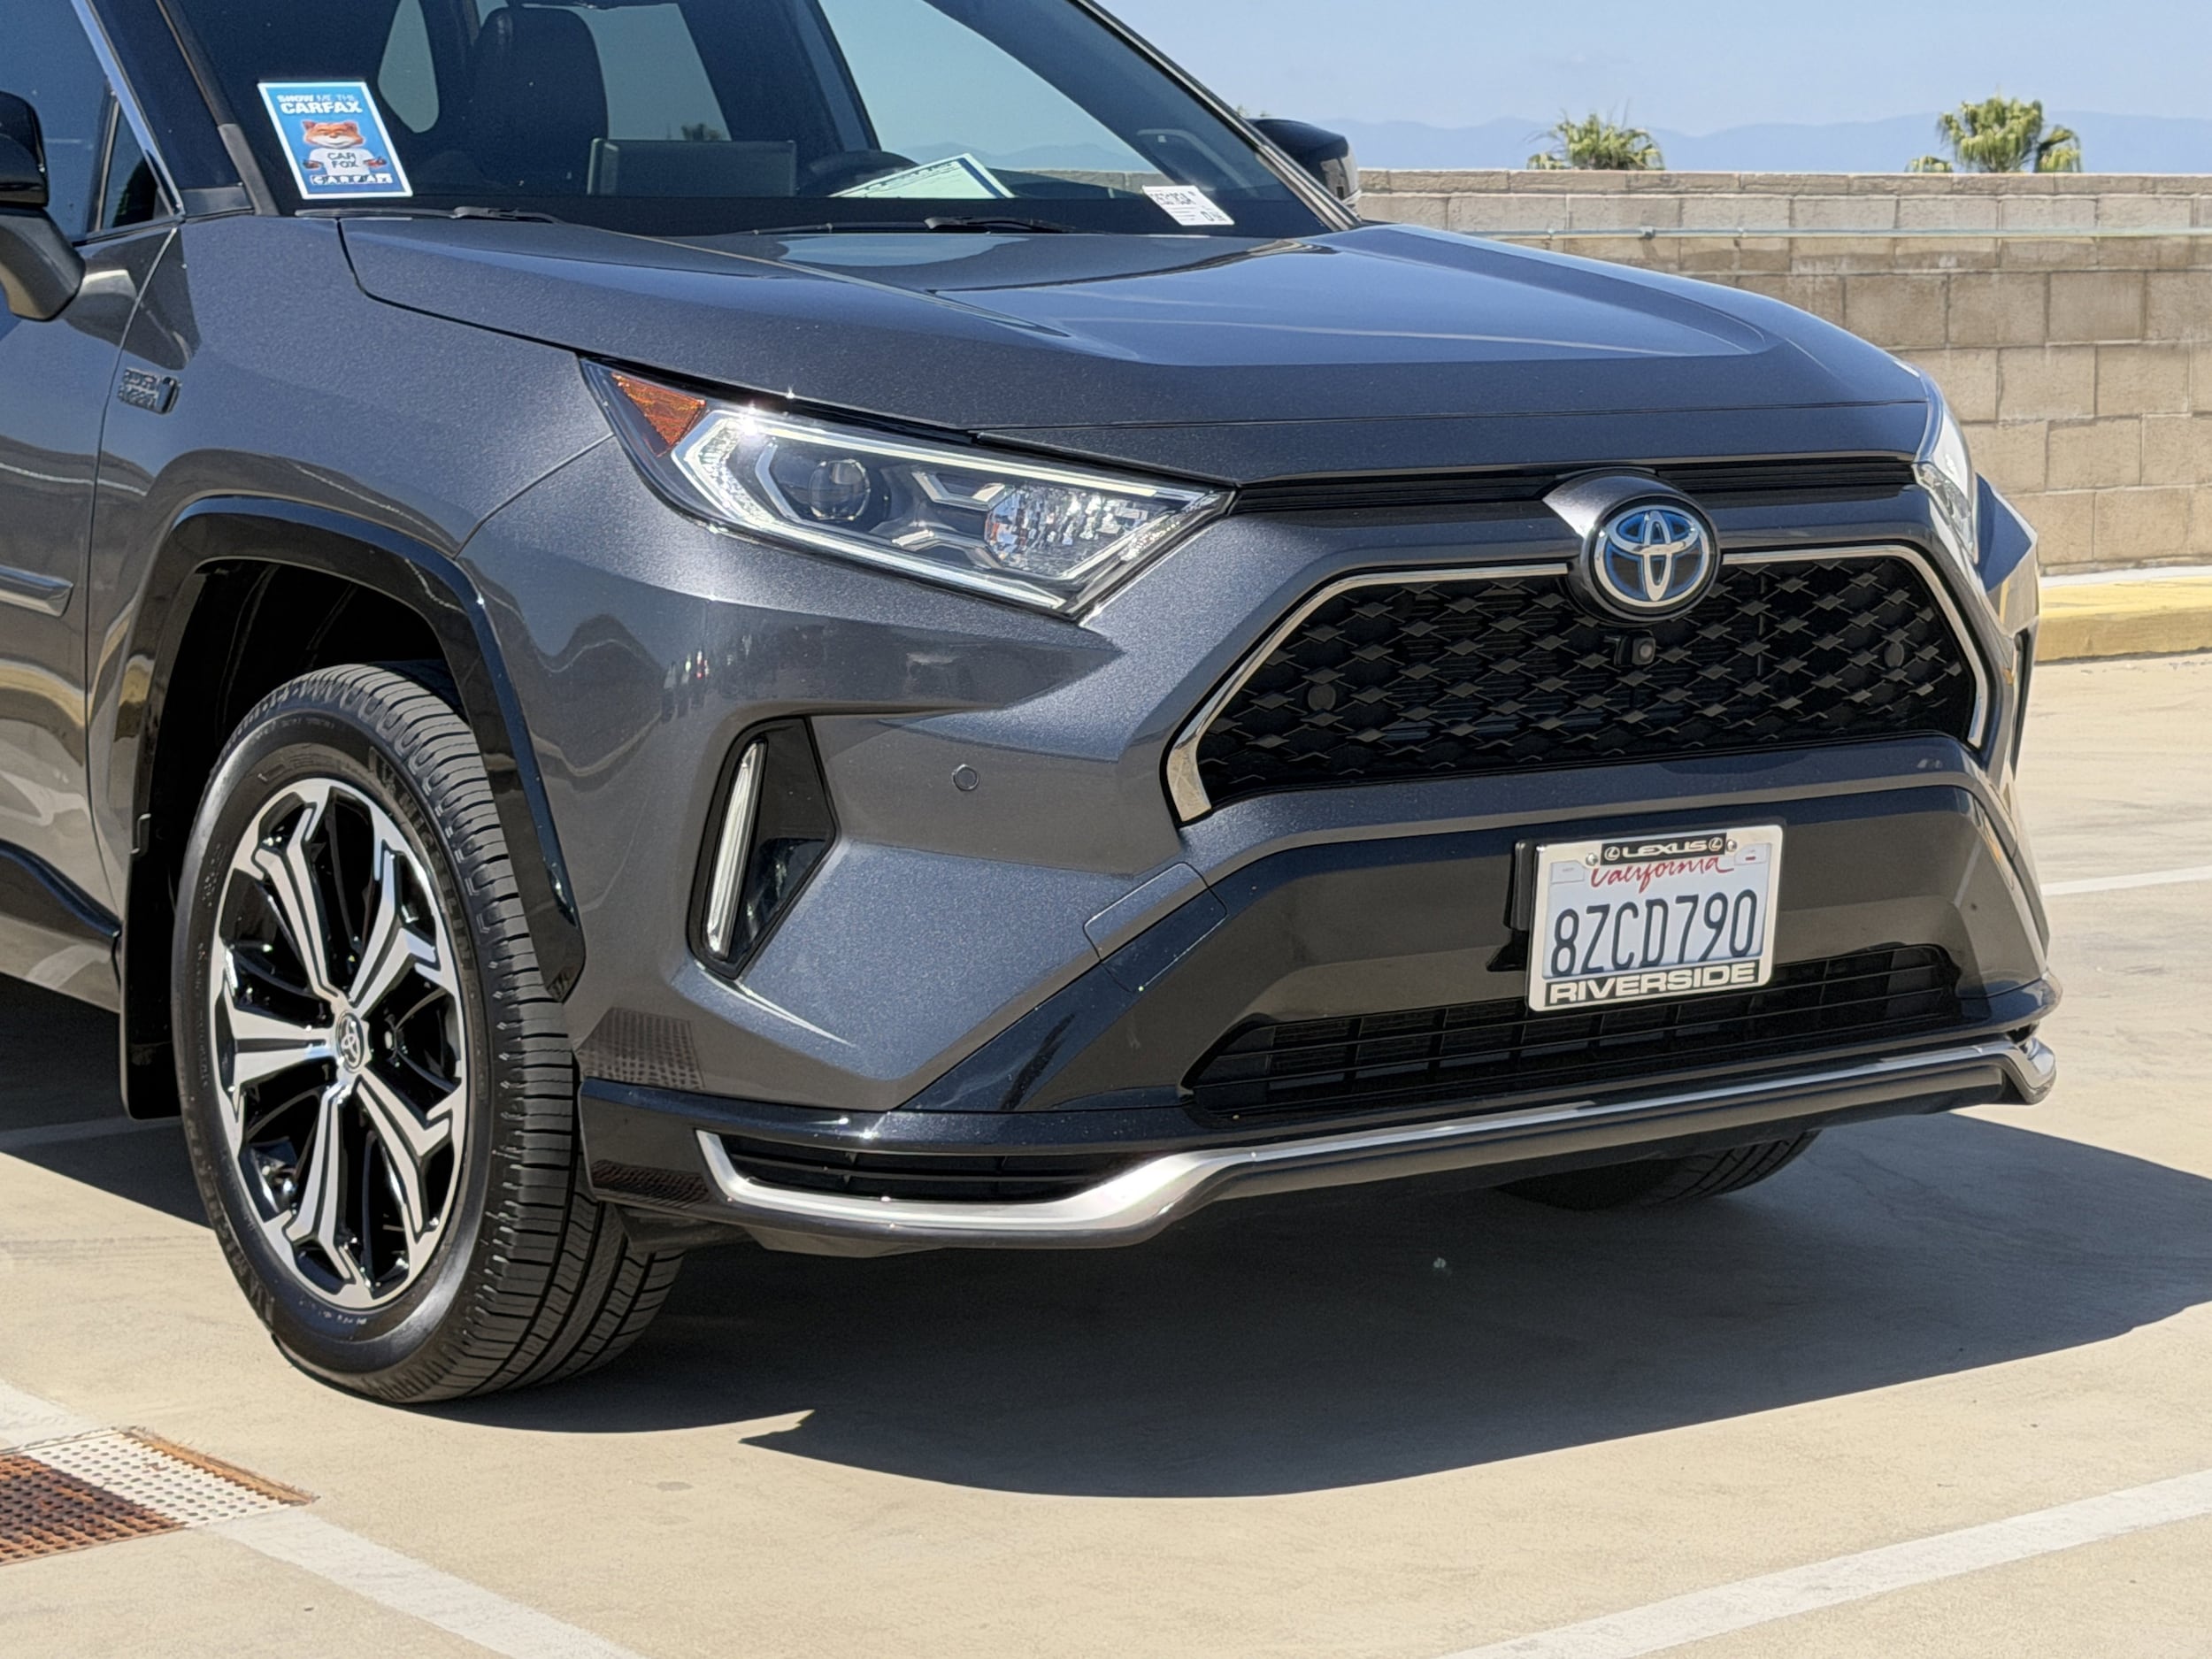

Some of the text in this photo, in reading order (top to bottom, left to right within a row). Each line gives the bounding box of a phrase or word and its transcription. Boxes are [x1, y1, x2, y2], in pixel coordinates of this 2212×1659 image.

[280, 102, 363, 114] CARFAX
[311, 173, 394, 185] CARFAX
[1622, 840, 1708, 858] LEXUS
[1591, 856, 1734, 894] California
[1550, 888, 1758, 977] 8ZCD790
[1550, 962, 1756, 1004] RIVERSIDE
